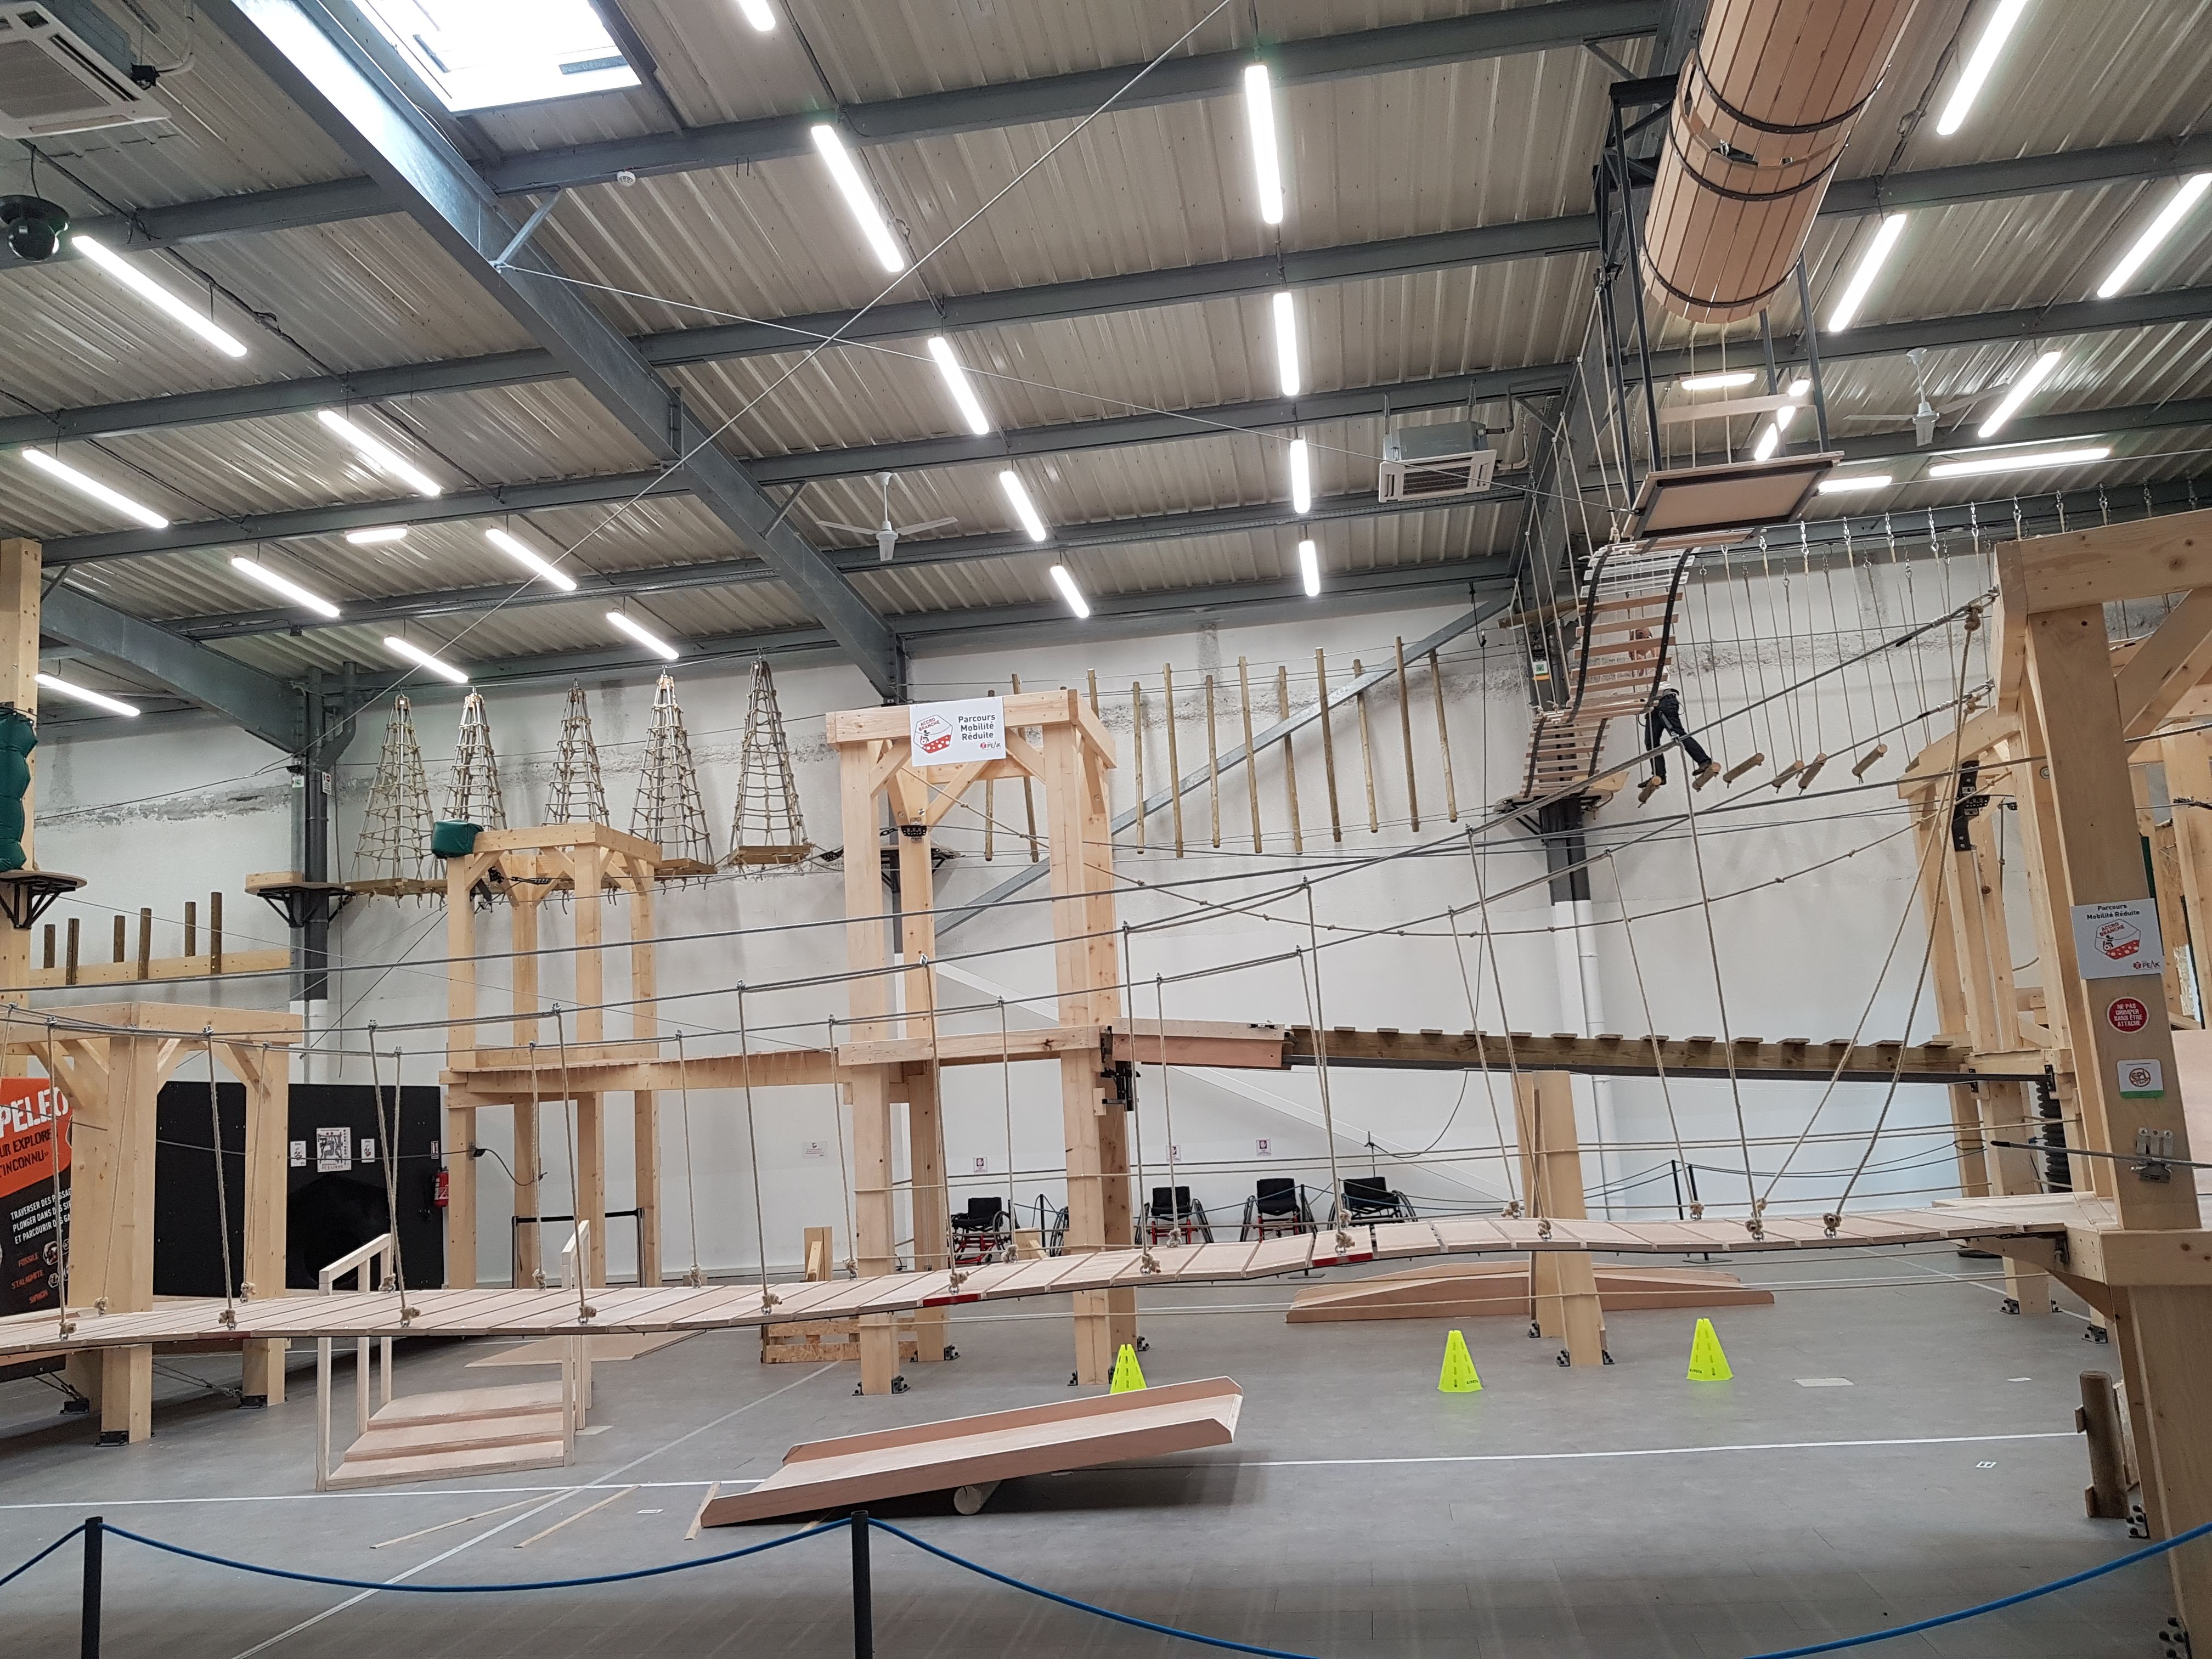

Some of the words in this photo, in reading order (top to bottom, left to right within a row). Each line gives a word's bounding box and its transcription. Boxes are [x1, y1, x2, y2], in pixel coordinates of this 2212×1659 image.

[920, 718, 936, 726] ACCRO
[958, 714, 995, 723] Parcours
[918, 720, 940, 731] BRANCHE
[961, 721, 994, 732] Mobilité
[962, 732, 994, 741] Réduite
[2100, 924, 2125, 936] BRANCHE
[2102, 922, 2119, 931] ACCRO
[13, 1128, 58, 1153] EXPLORE
[10, 1201, 41, 1221] TRAVERSER
[41, 1197, 52, 1207] DES
[13, 1215, 36, 1233] PLONGER
[37, 1209, 52, 1222] DANS
[52, 1205, 63, 1215] DS
[15, 1234, 21, 1245] ET
[22, 1221, 52, 1241] PARCOURIR
[53, 1217, 63, 1228] DS
